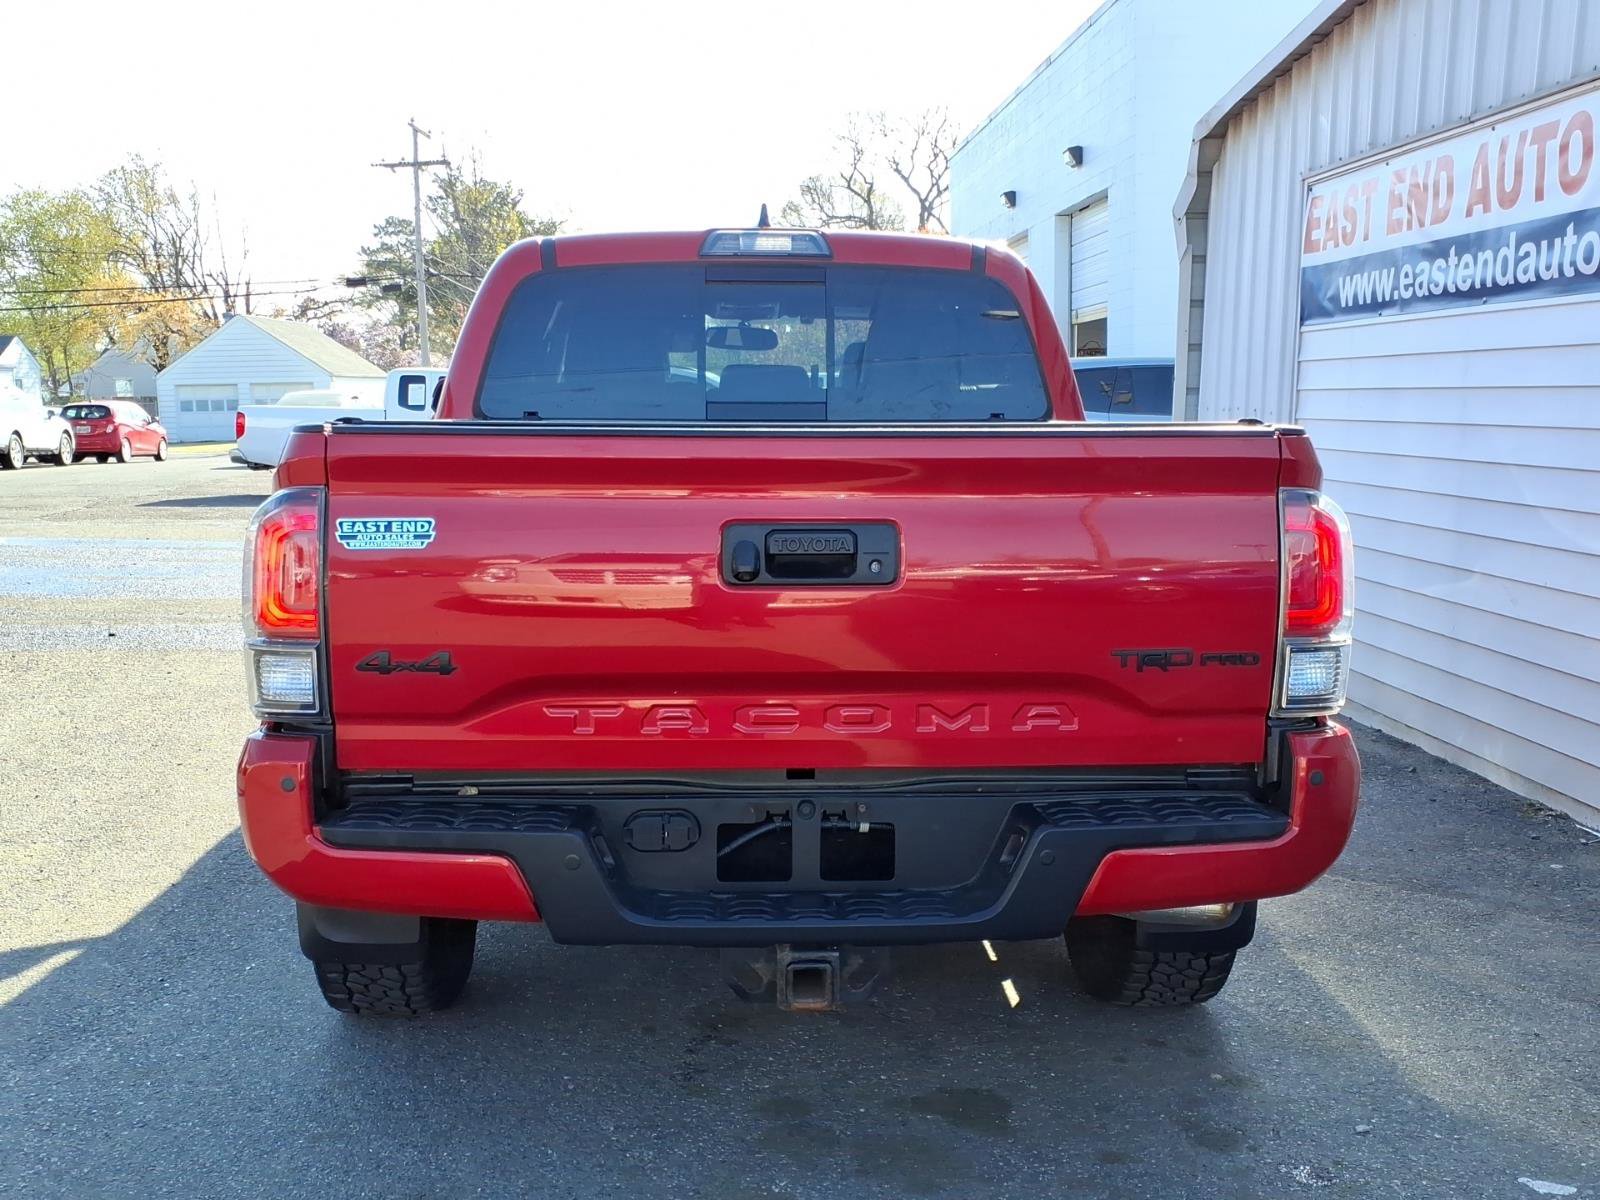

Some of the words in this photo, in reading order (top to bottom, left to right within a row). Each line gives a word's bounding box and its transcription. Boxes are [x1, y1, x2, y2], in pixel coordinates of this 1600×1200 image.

[1302, 176, 1380, 255] EAST
[1386, 154, 1455, 236] END
[1465, 110, 1595, 219] AUTO
[1338, 221, 1600, 309] www.eastendauto
[342, 521, 388, 533] EAST
[391, 521, 430, 533] END
[356, 533, 383, 541] AUTO
[384, 533, 415, 541] SALES
[774, 536, 850, 552] TOYOTA
[1111, 648, 1194, 673] TRD
[1200, 651, 1260, 667] PRO
[542, 703, 1079, 734] TACOMA
